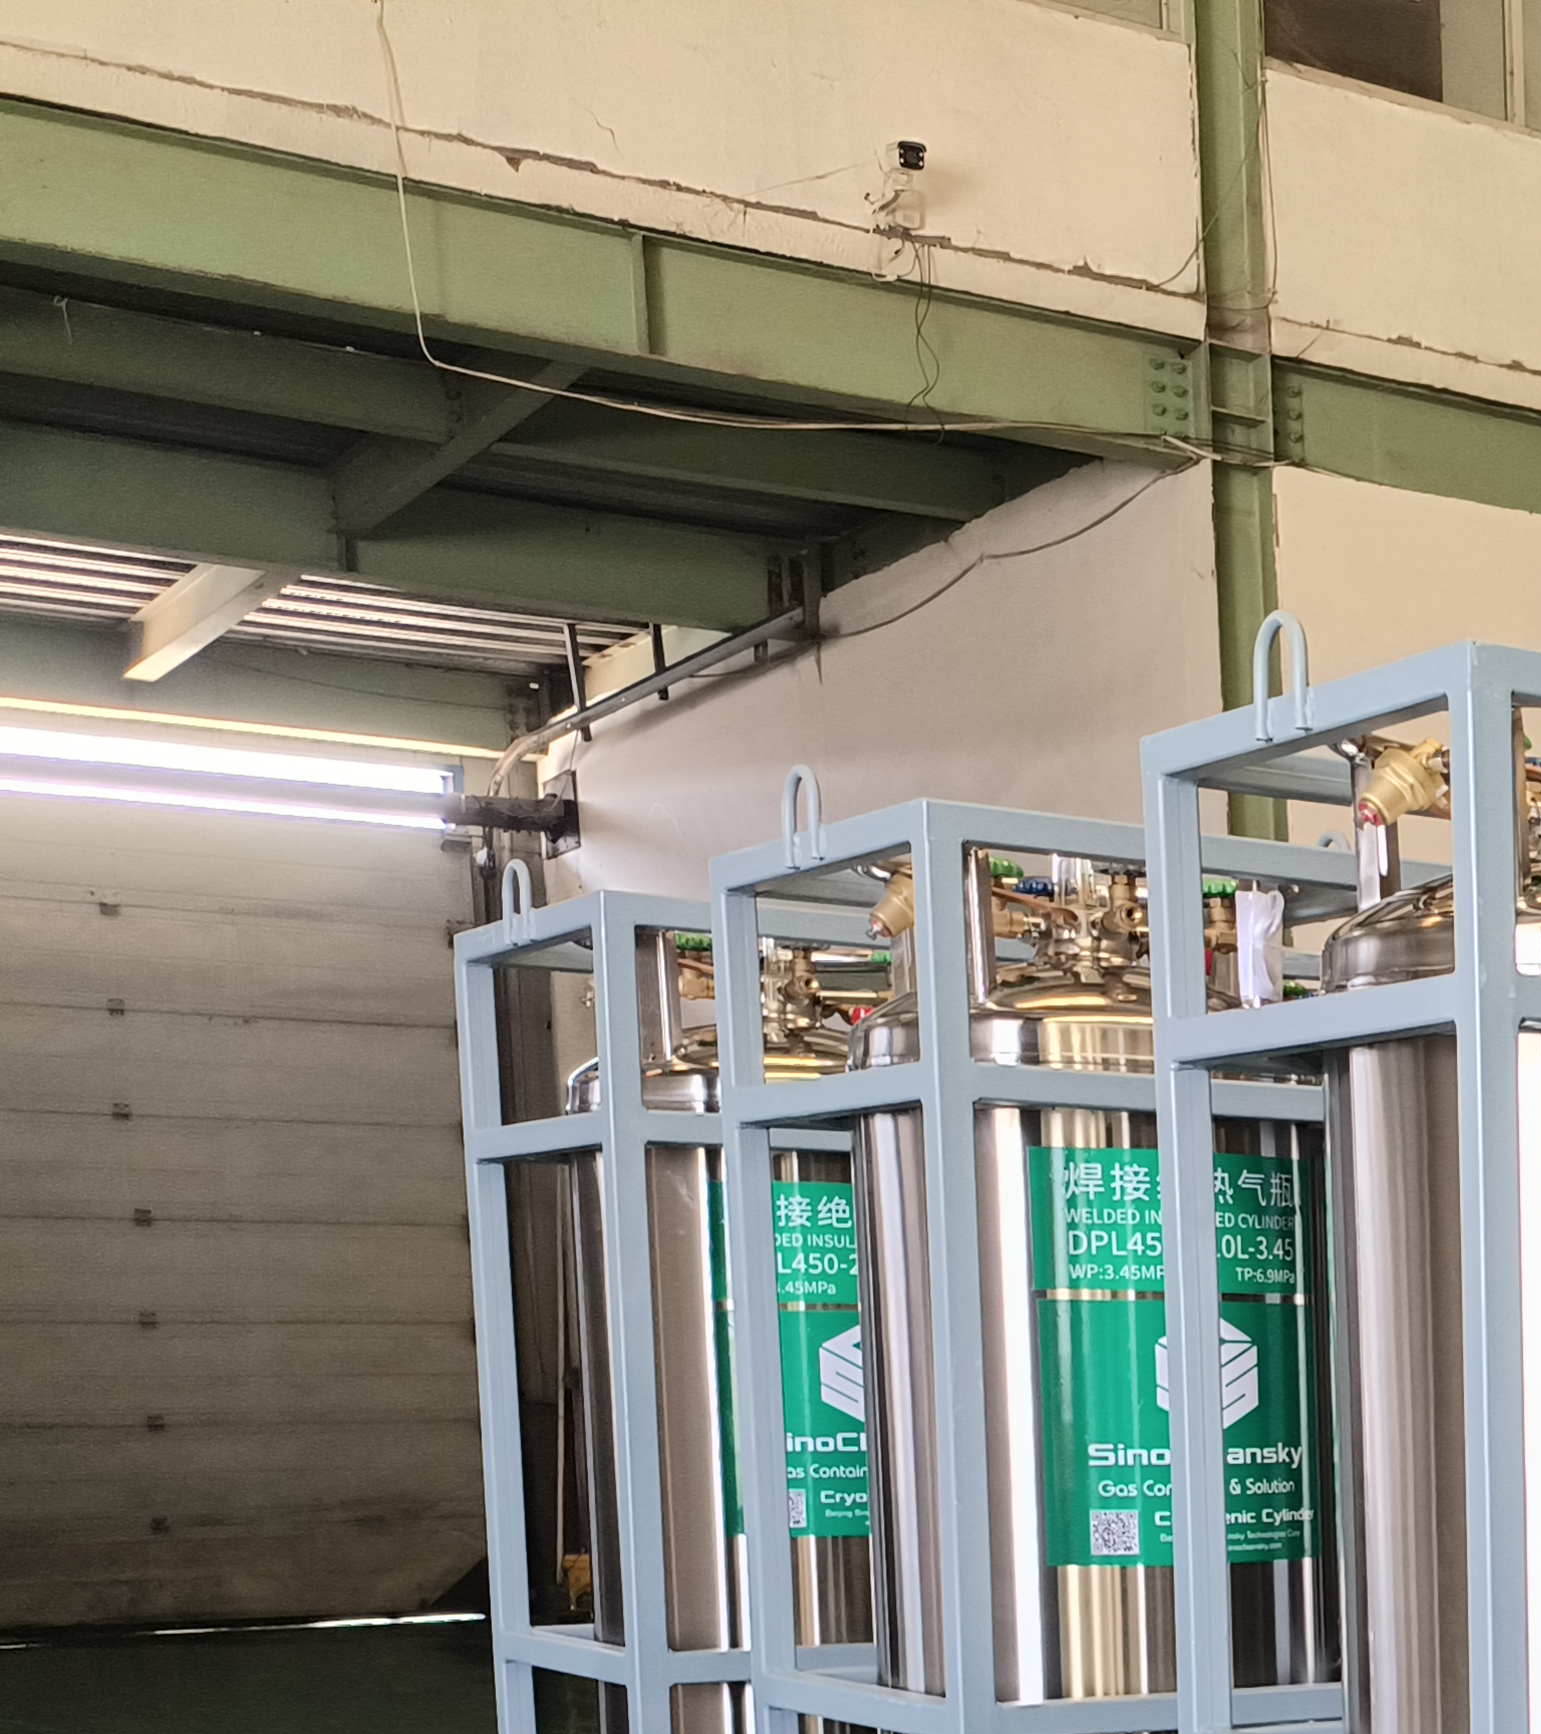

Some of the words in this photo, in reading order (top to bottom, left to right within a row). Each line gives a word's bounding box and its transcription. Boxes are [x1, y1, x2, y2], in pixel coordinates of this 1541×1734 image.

[1066, 1208, 1140, 1225] WELDED
[1238, 1213, 1295, 1231] CYLINDER
[1235, 1266, 1295, 1284] TP:6.9MPa
[1099, 1480, 1137, 1497] Gas
[1229, 1479, 1241, 1495] &
[1246, 1478, 1295, 1495] Solution
